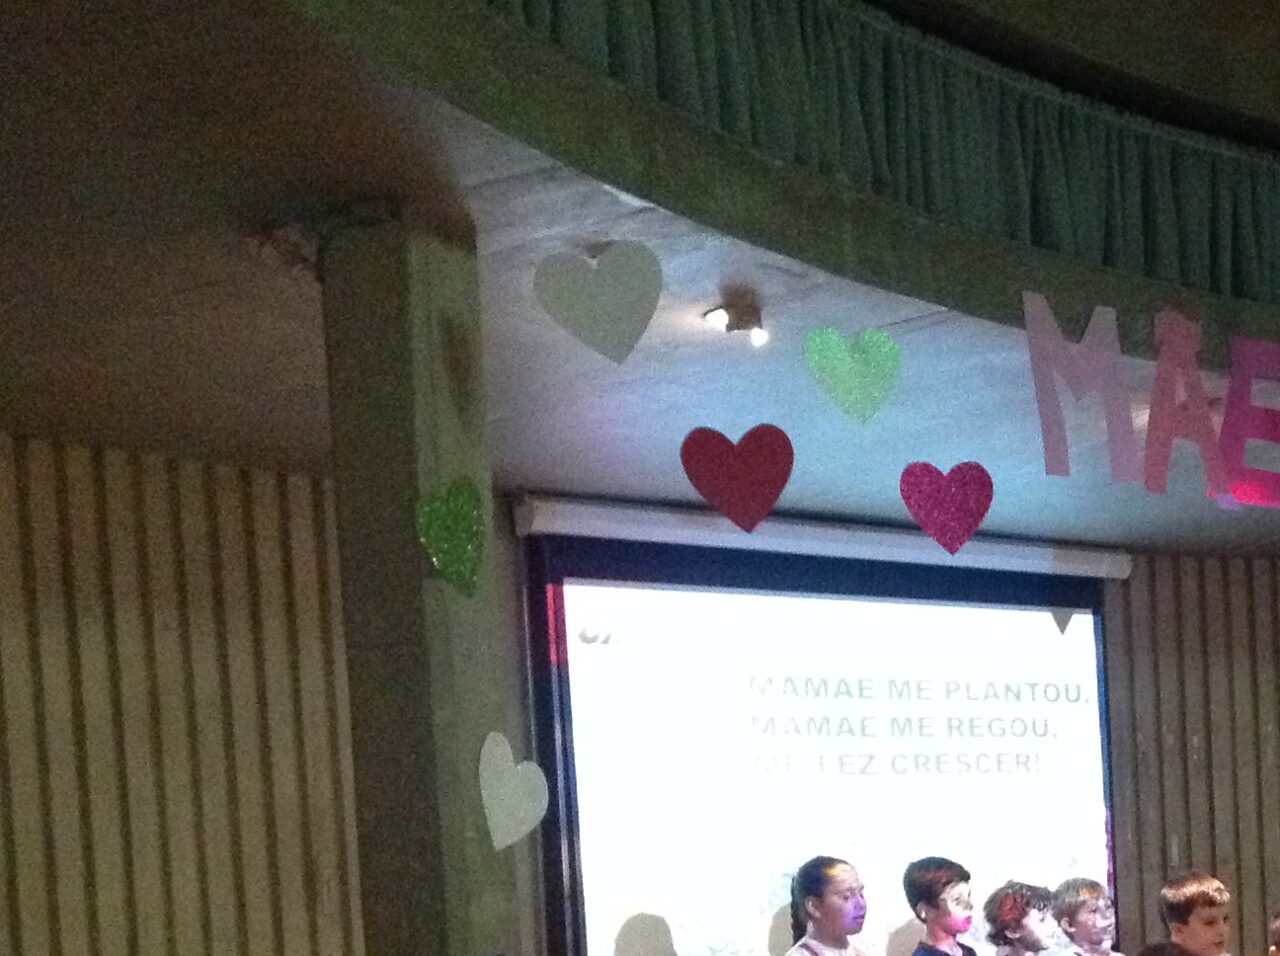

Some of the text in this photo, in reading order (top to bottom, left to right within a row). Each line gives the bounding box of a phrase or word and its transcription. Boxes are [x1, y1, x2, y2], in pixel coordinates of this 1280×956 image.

[887, 678, 933, 702] ME
[889, 715, 935, 739] ME
[889, 752, 1042, 777] CRESCER!
